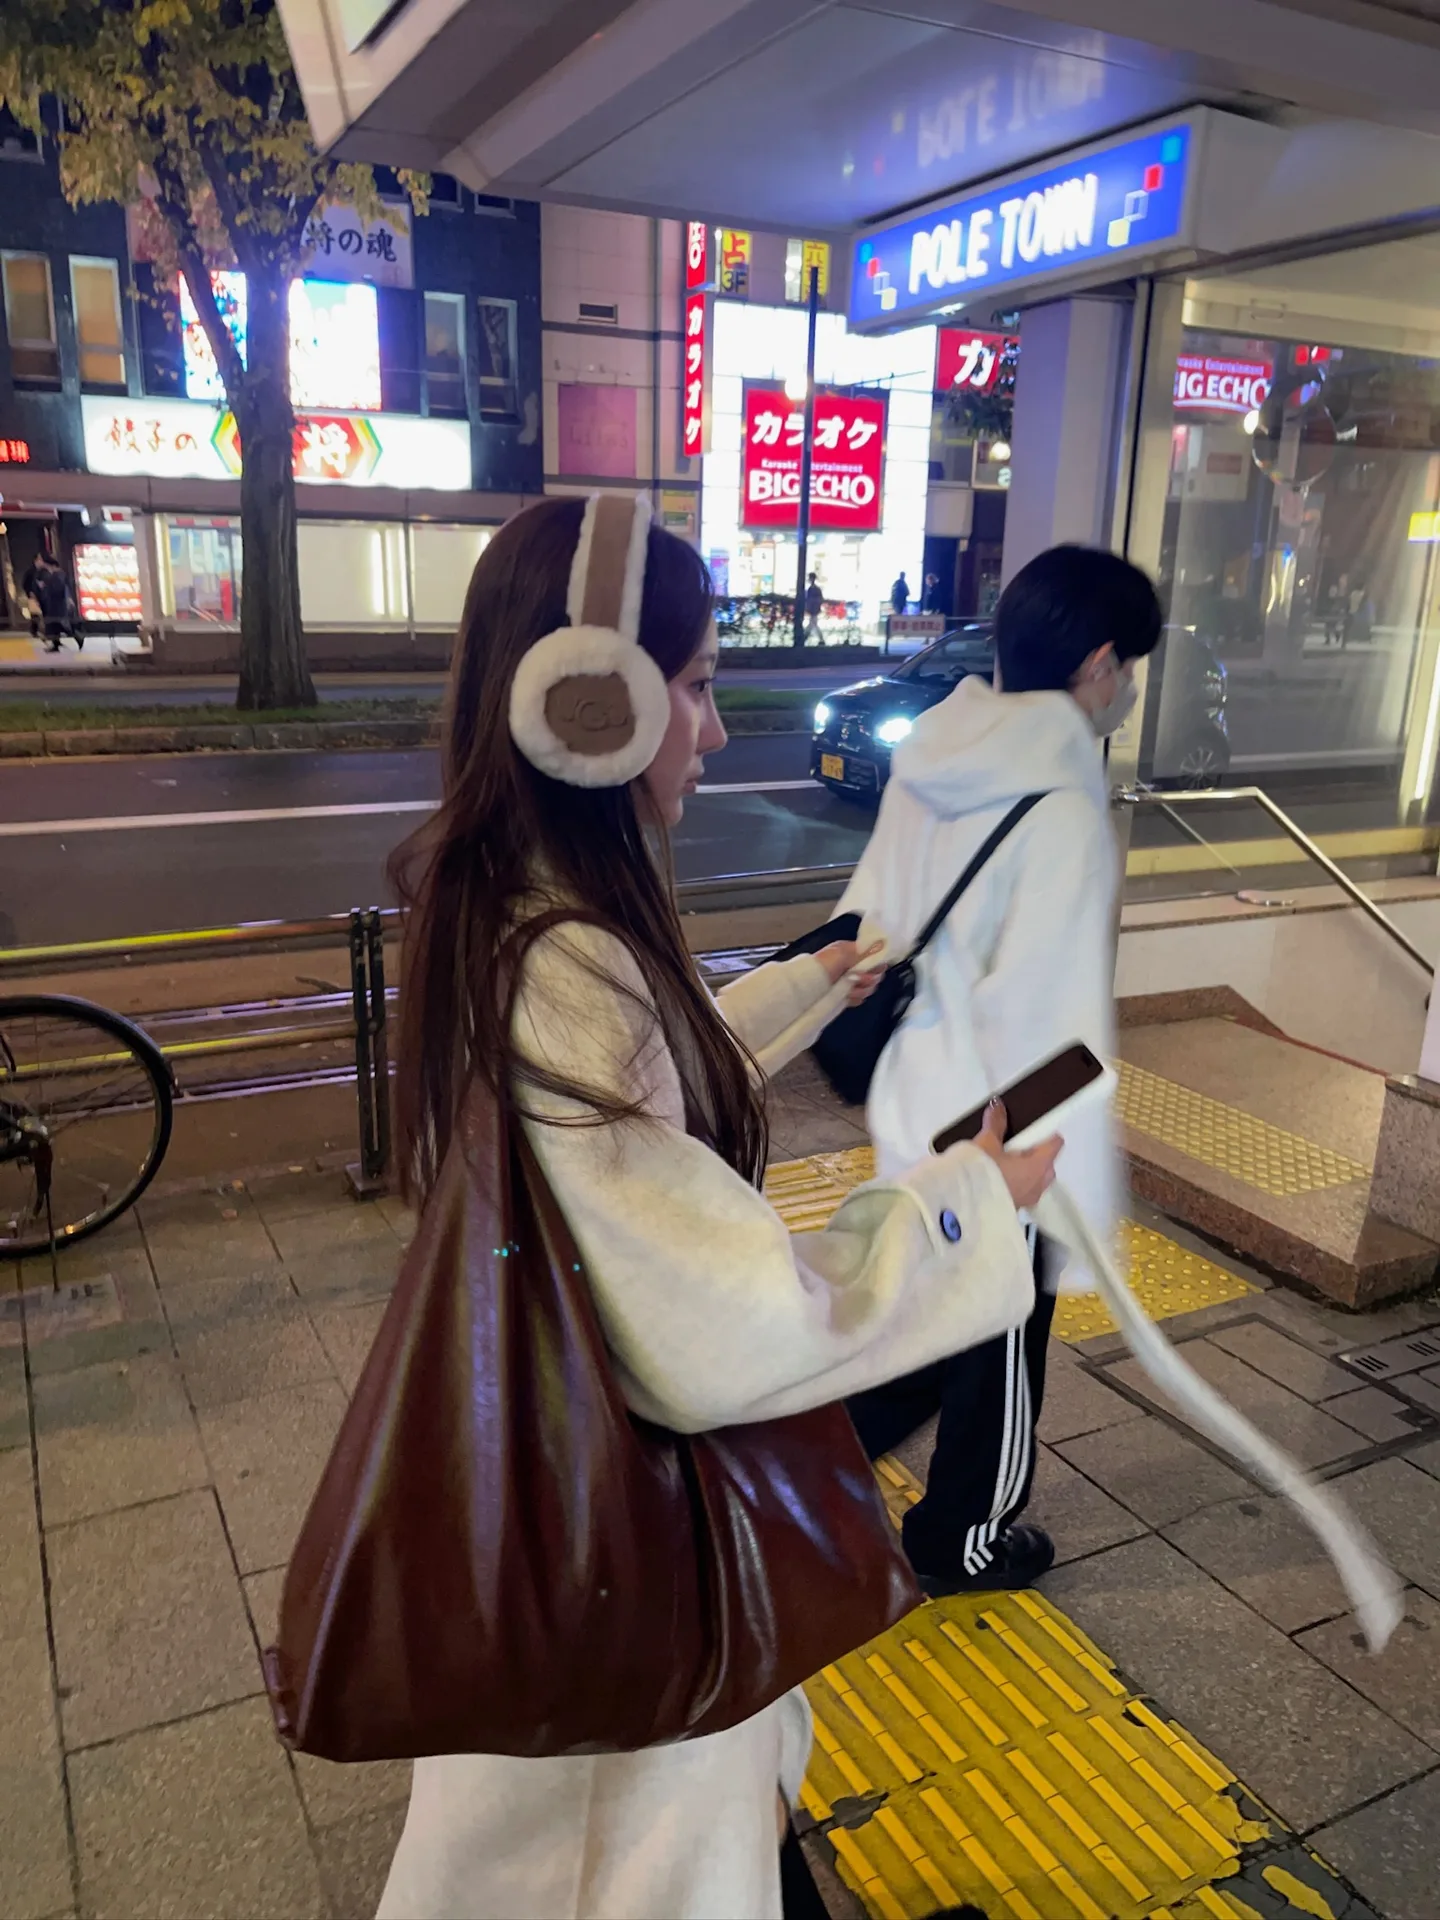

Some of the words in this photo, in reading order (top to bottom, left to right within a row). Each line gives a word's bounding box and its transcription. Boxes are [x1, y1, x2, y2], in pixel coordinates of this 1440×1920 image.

[908, 209, 993, 294] POLE
[999, 173, 1098, 268] TOWN
[723, 270, 747, 292] 3F
[686, 306, 703, 445] カラオケ
[1173, 371, 1205, 399] IG
[1206, 375, 1269, 409] ECHO
[751, 411, 878, 450] カラオケ
[748, 469, 800, 502] BIG
